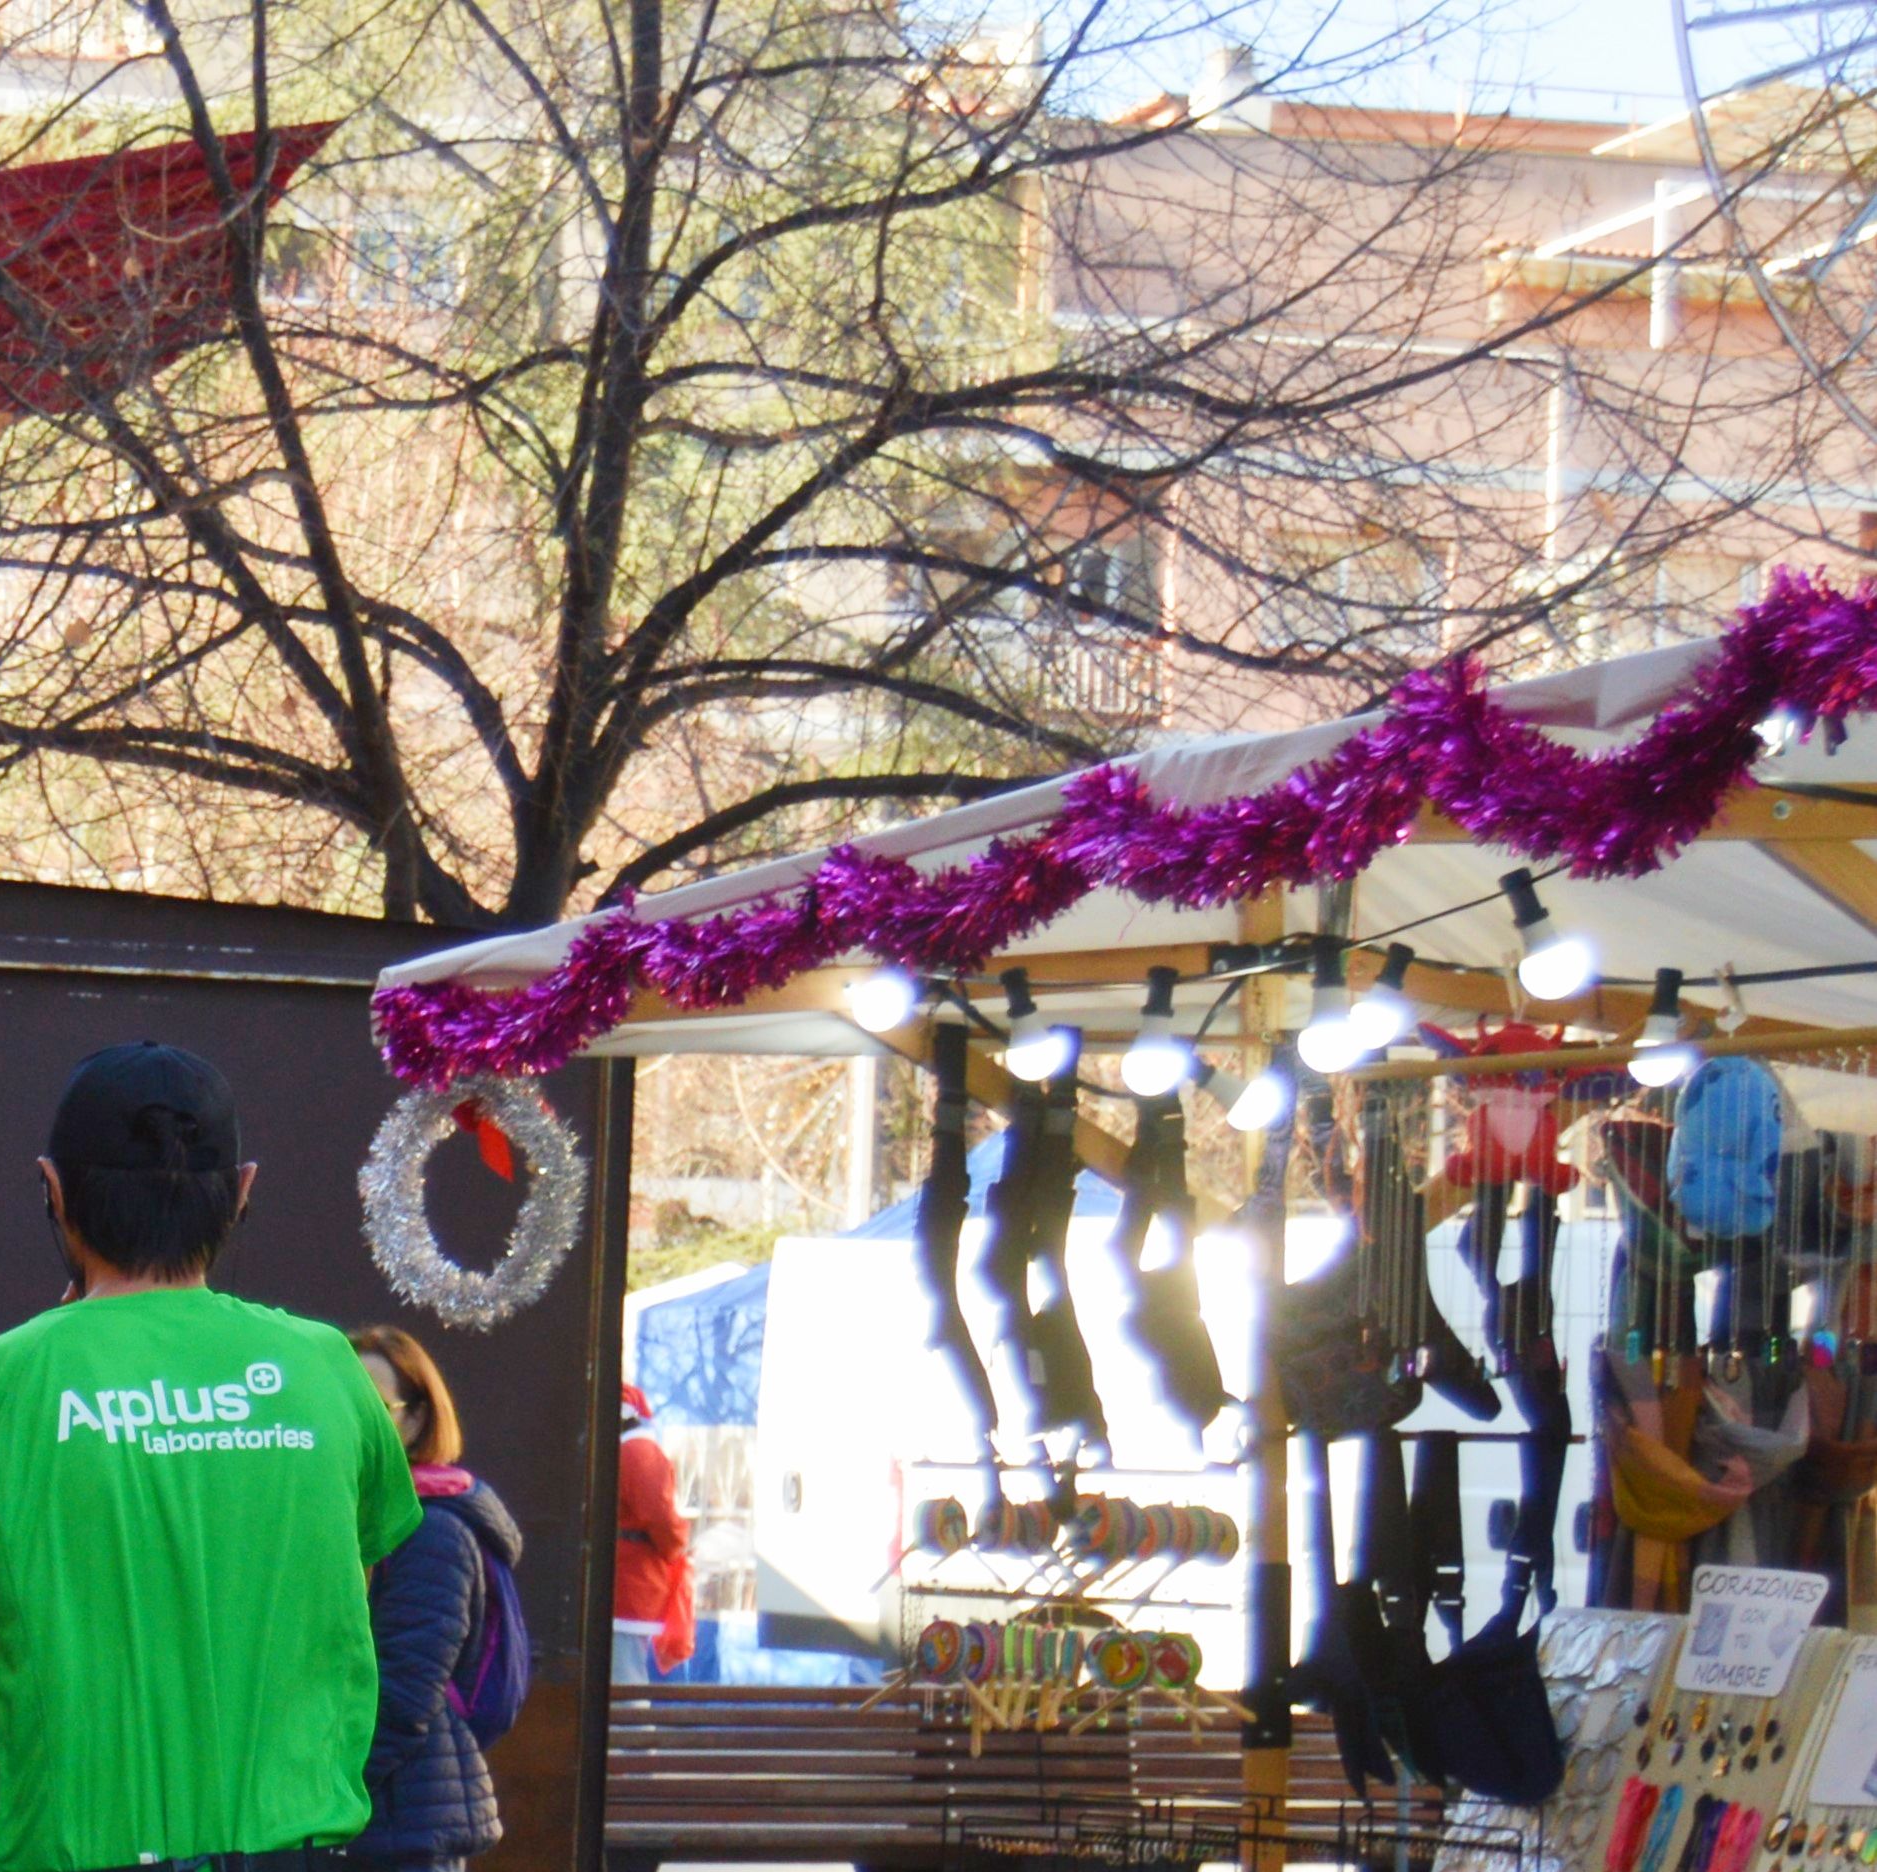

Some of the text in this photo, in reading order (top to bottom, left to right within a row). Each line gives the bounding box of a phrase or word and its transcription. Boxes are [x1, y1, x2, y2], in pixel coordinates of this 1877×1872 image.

[142, 1423, 314, 1455] laboratories
[1696, 1571, 1824, 1603] CORAZONES
[1694, 1663, 1772, 1688] NOMBRE
